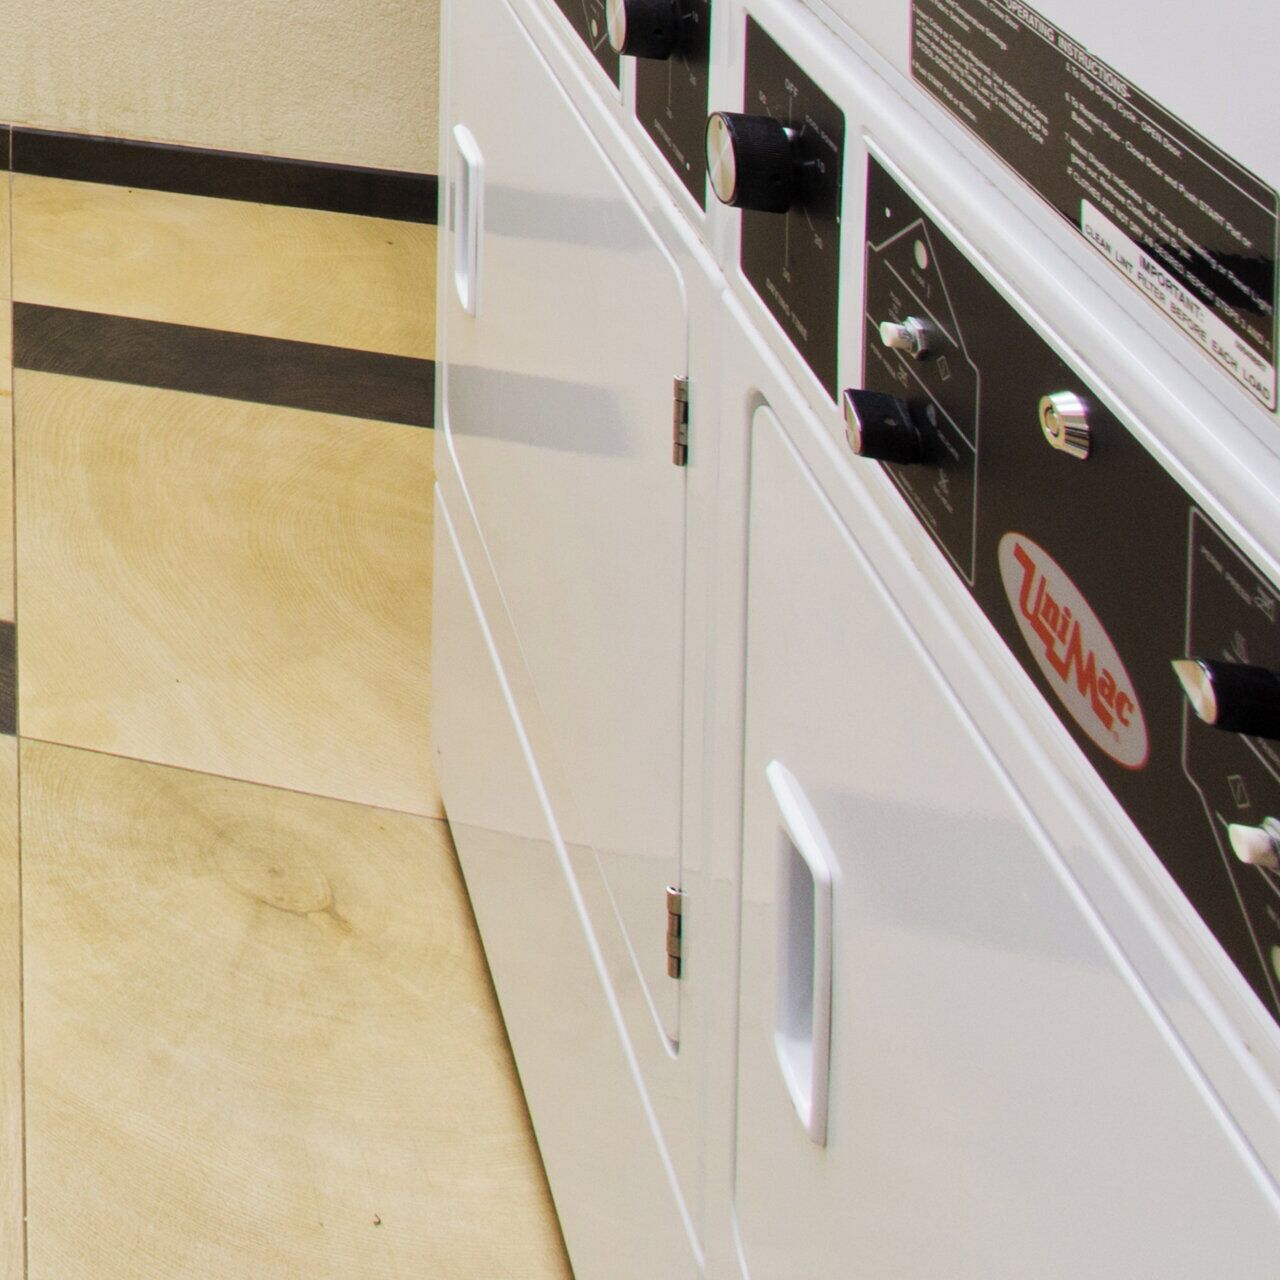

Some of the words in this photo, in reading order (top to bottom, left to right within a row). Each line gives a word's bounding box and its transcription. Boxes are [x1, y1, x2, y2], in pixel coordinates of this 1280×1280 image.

[784, 78, 800, 98] OFF
[1086, 225, 1111, 253] CLEAN
[1116, 254, 1133, 272] LINT
[1138, 272, 1165, 301] FILTER
[1171, 303, 1206, 341] BEFORE
[1212, 341, 1237, 368] EACH
[1244, 370, 1269, 400] LOAD
[1140, 258, 1201, 318] IMPORTANT:
[1013, 542, 1135, 733] UniMac
